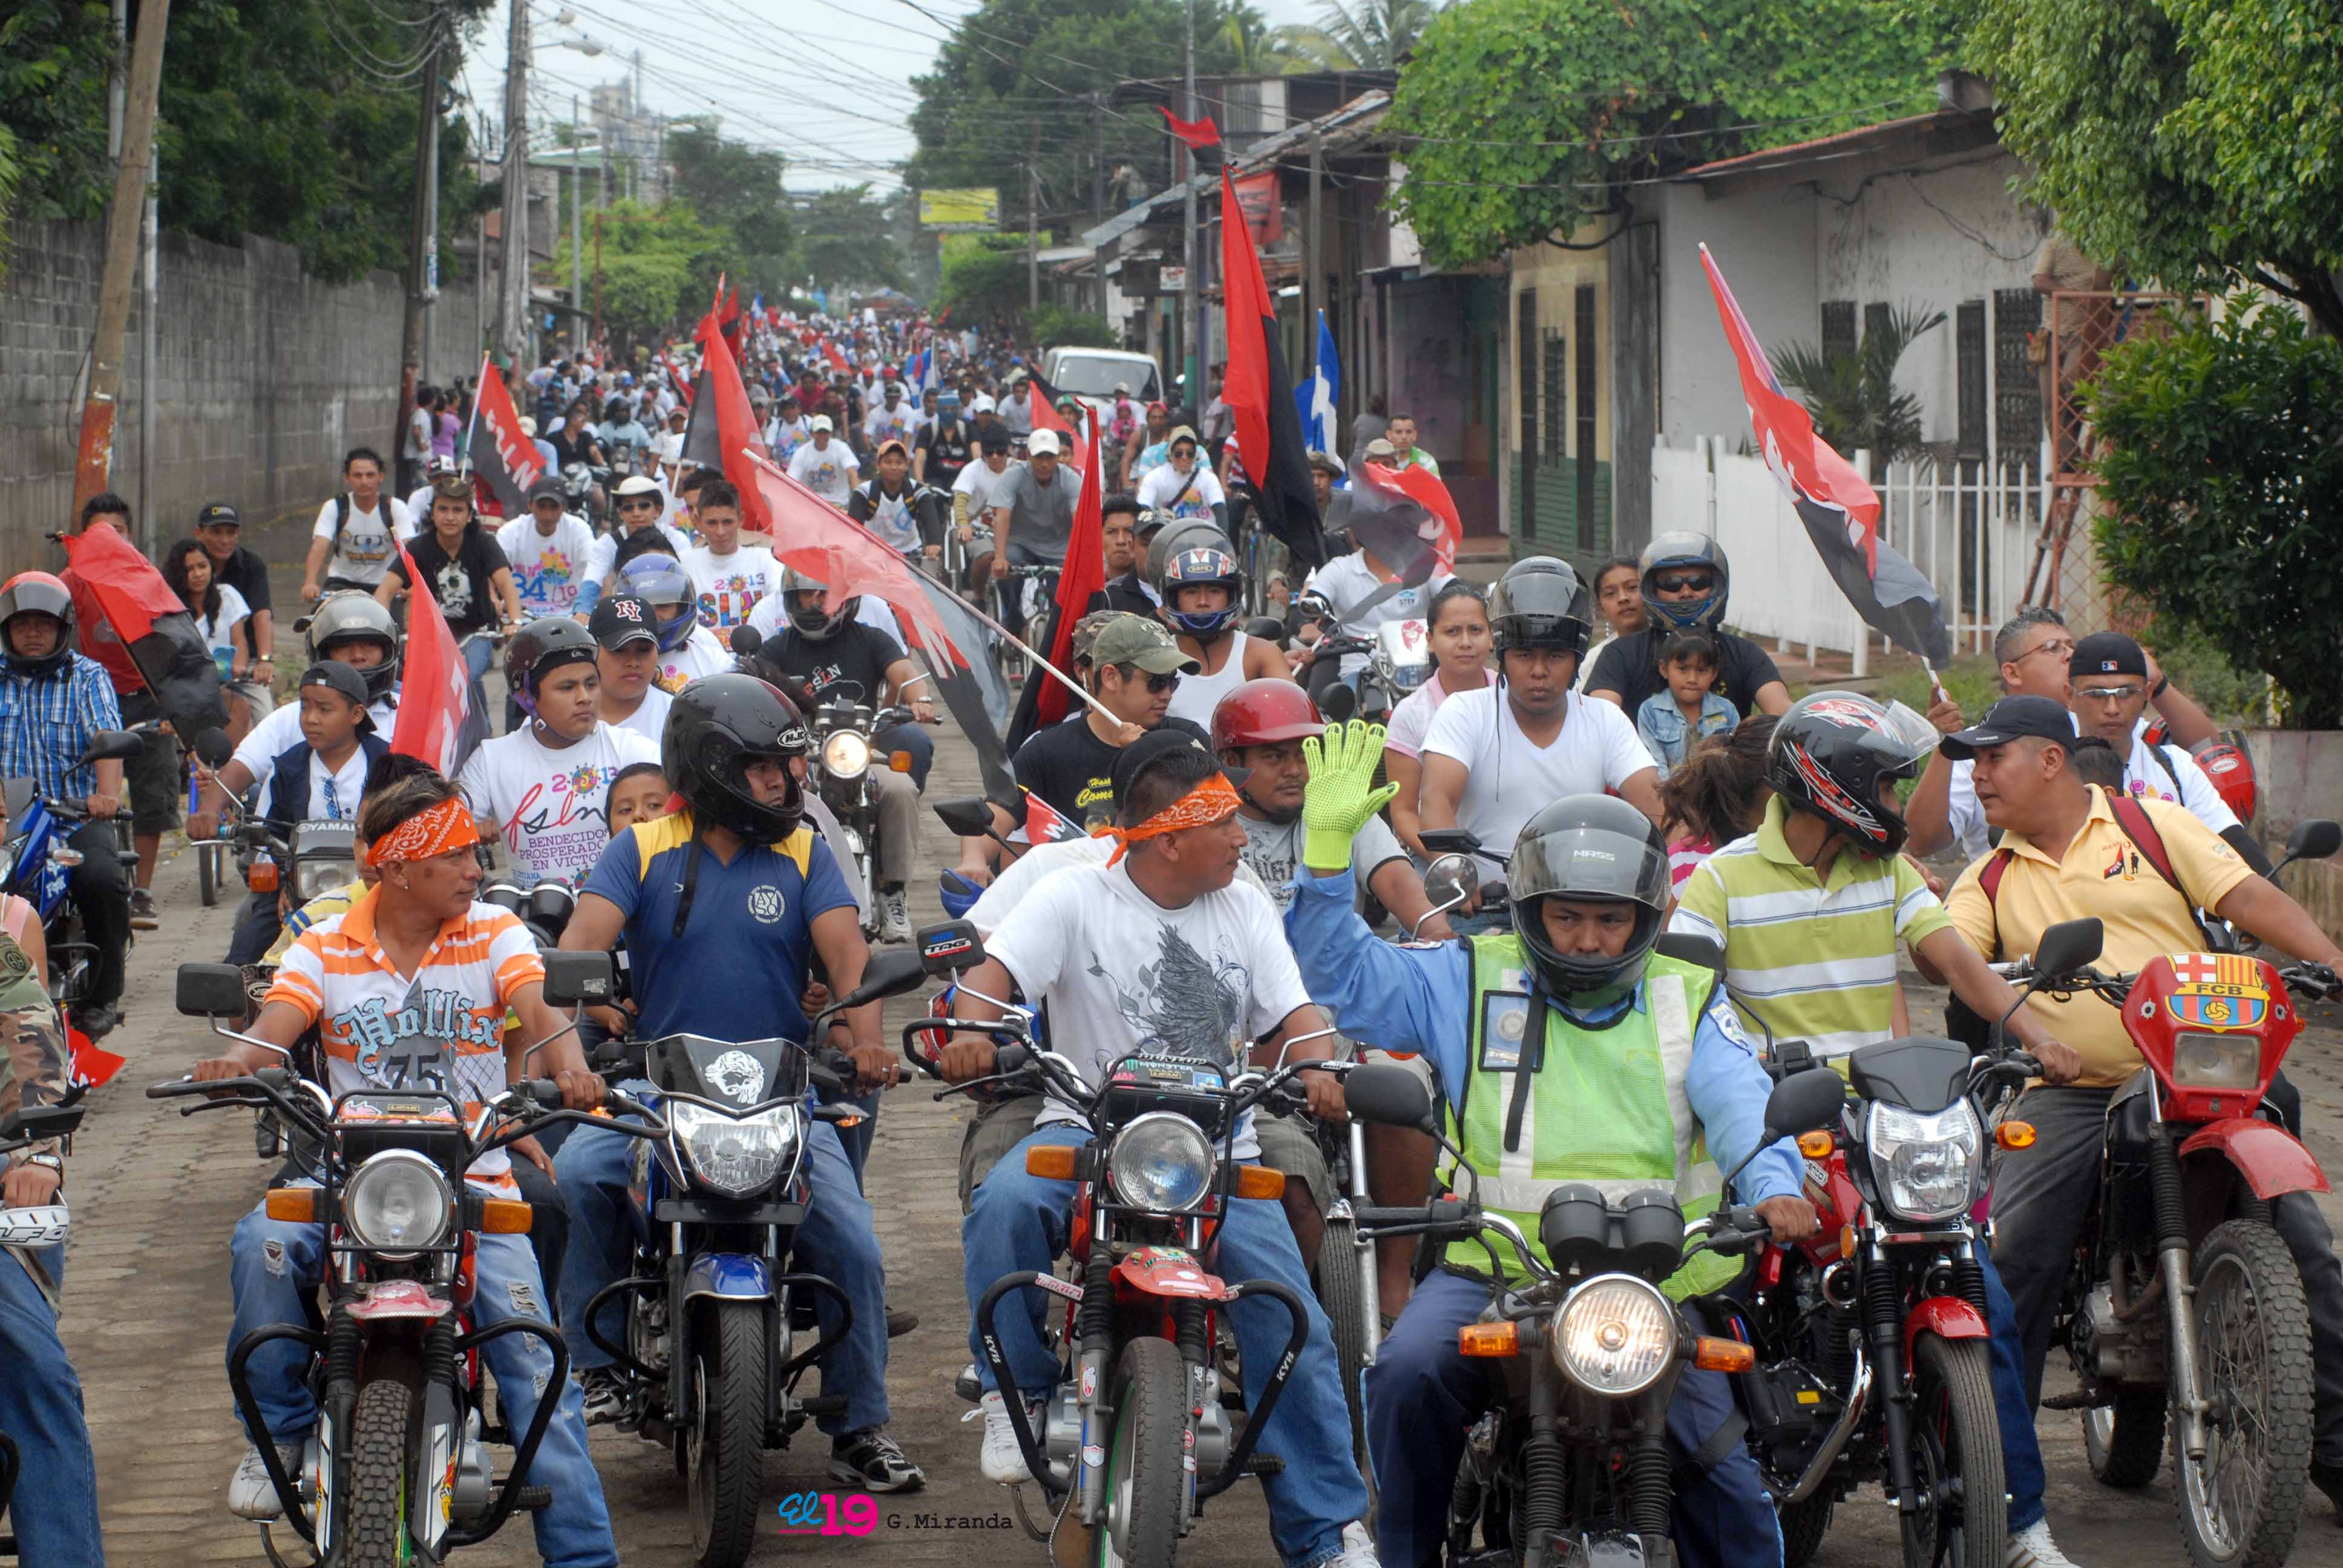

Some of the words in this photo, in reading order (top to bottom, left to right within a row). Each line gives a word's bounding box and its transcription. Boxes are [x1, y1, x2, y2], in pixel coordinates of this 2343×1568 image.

[615, 600, 643, 622] NY
[310, 823, 355, 831] YAMA
[519, 839, 605, 860] PROSPERADO
[1573, 850, 1615, 861] MASS
[532, 859, 549, 871] EN
[555, 851, 601, 869] VICTO
[926, 939, 967, 954] TAG
[2196, 984, 2243, 995] FCB
[1139, 1061, 1194, 1072] MONSTER
